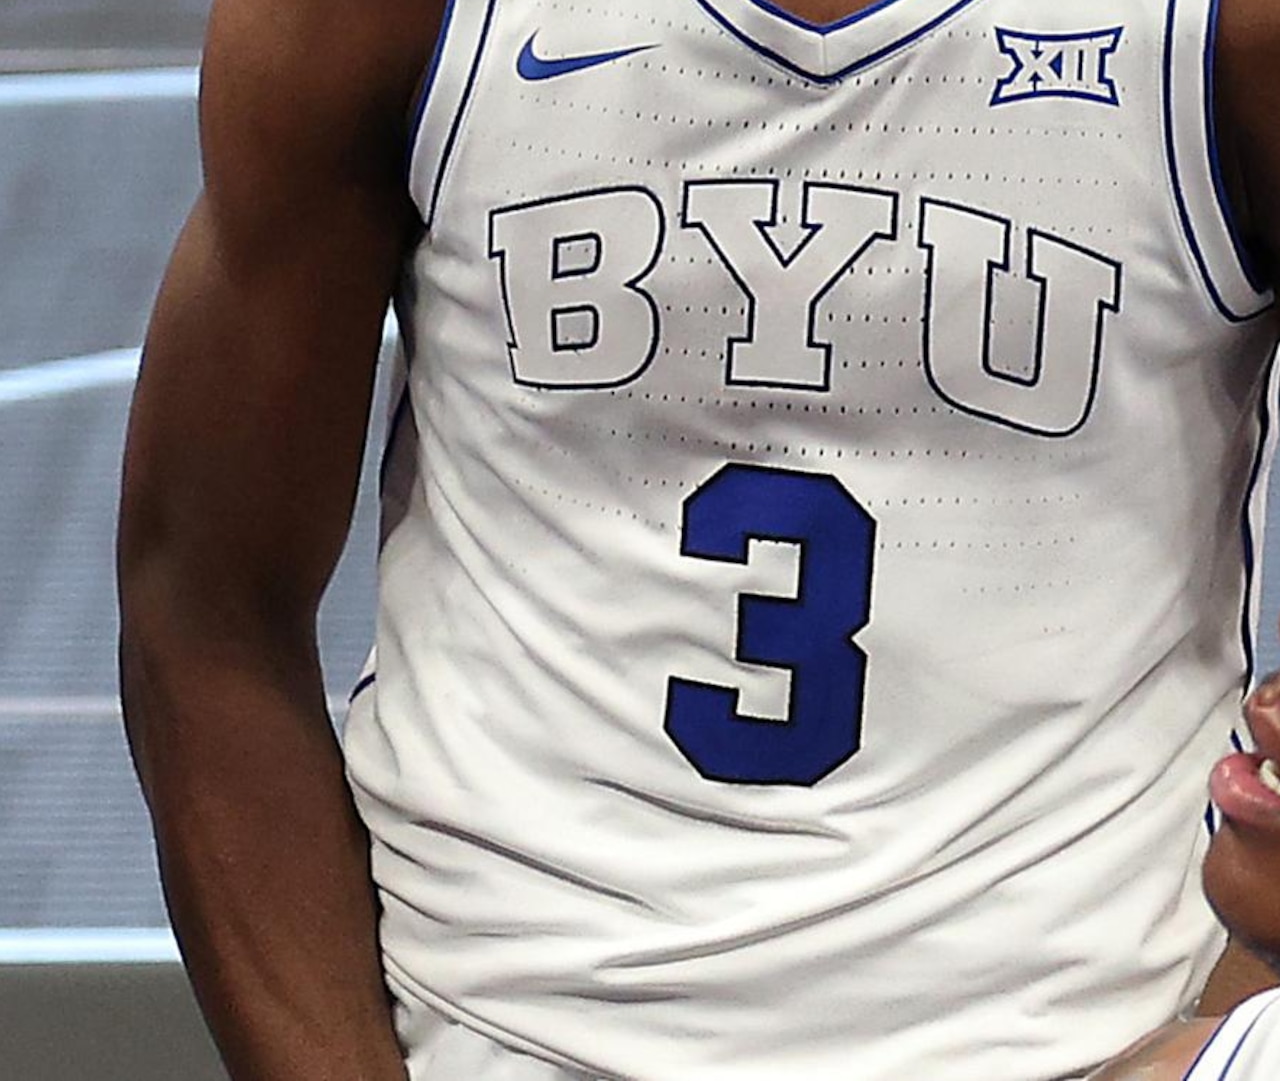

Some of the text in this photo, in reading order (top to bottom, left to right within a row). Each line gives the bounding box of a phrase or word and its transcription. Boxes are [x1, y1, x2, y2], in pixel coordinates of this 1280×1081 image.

[989, 26, 1125, 108] XII
[488, 178, 1123, 438] BYU
[663, 462, 878, 787] 3
